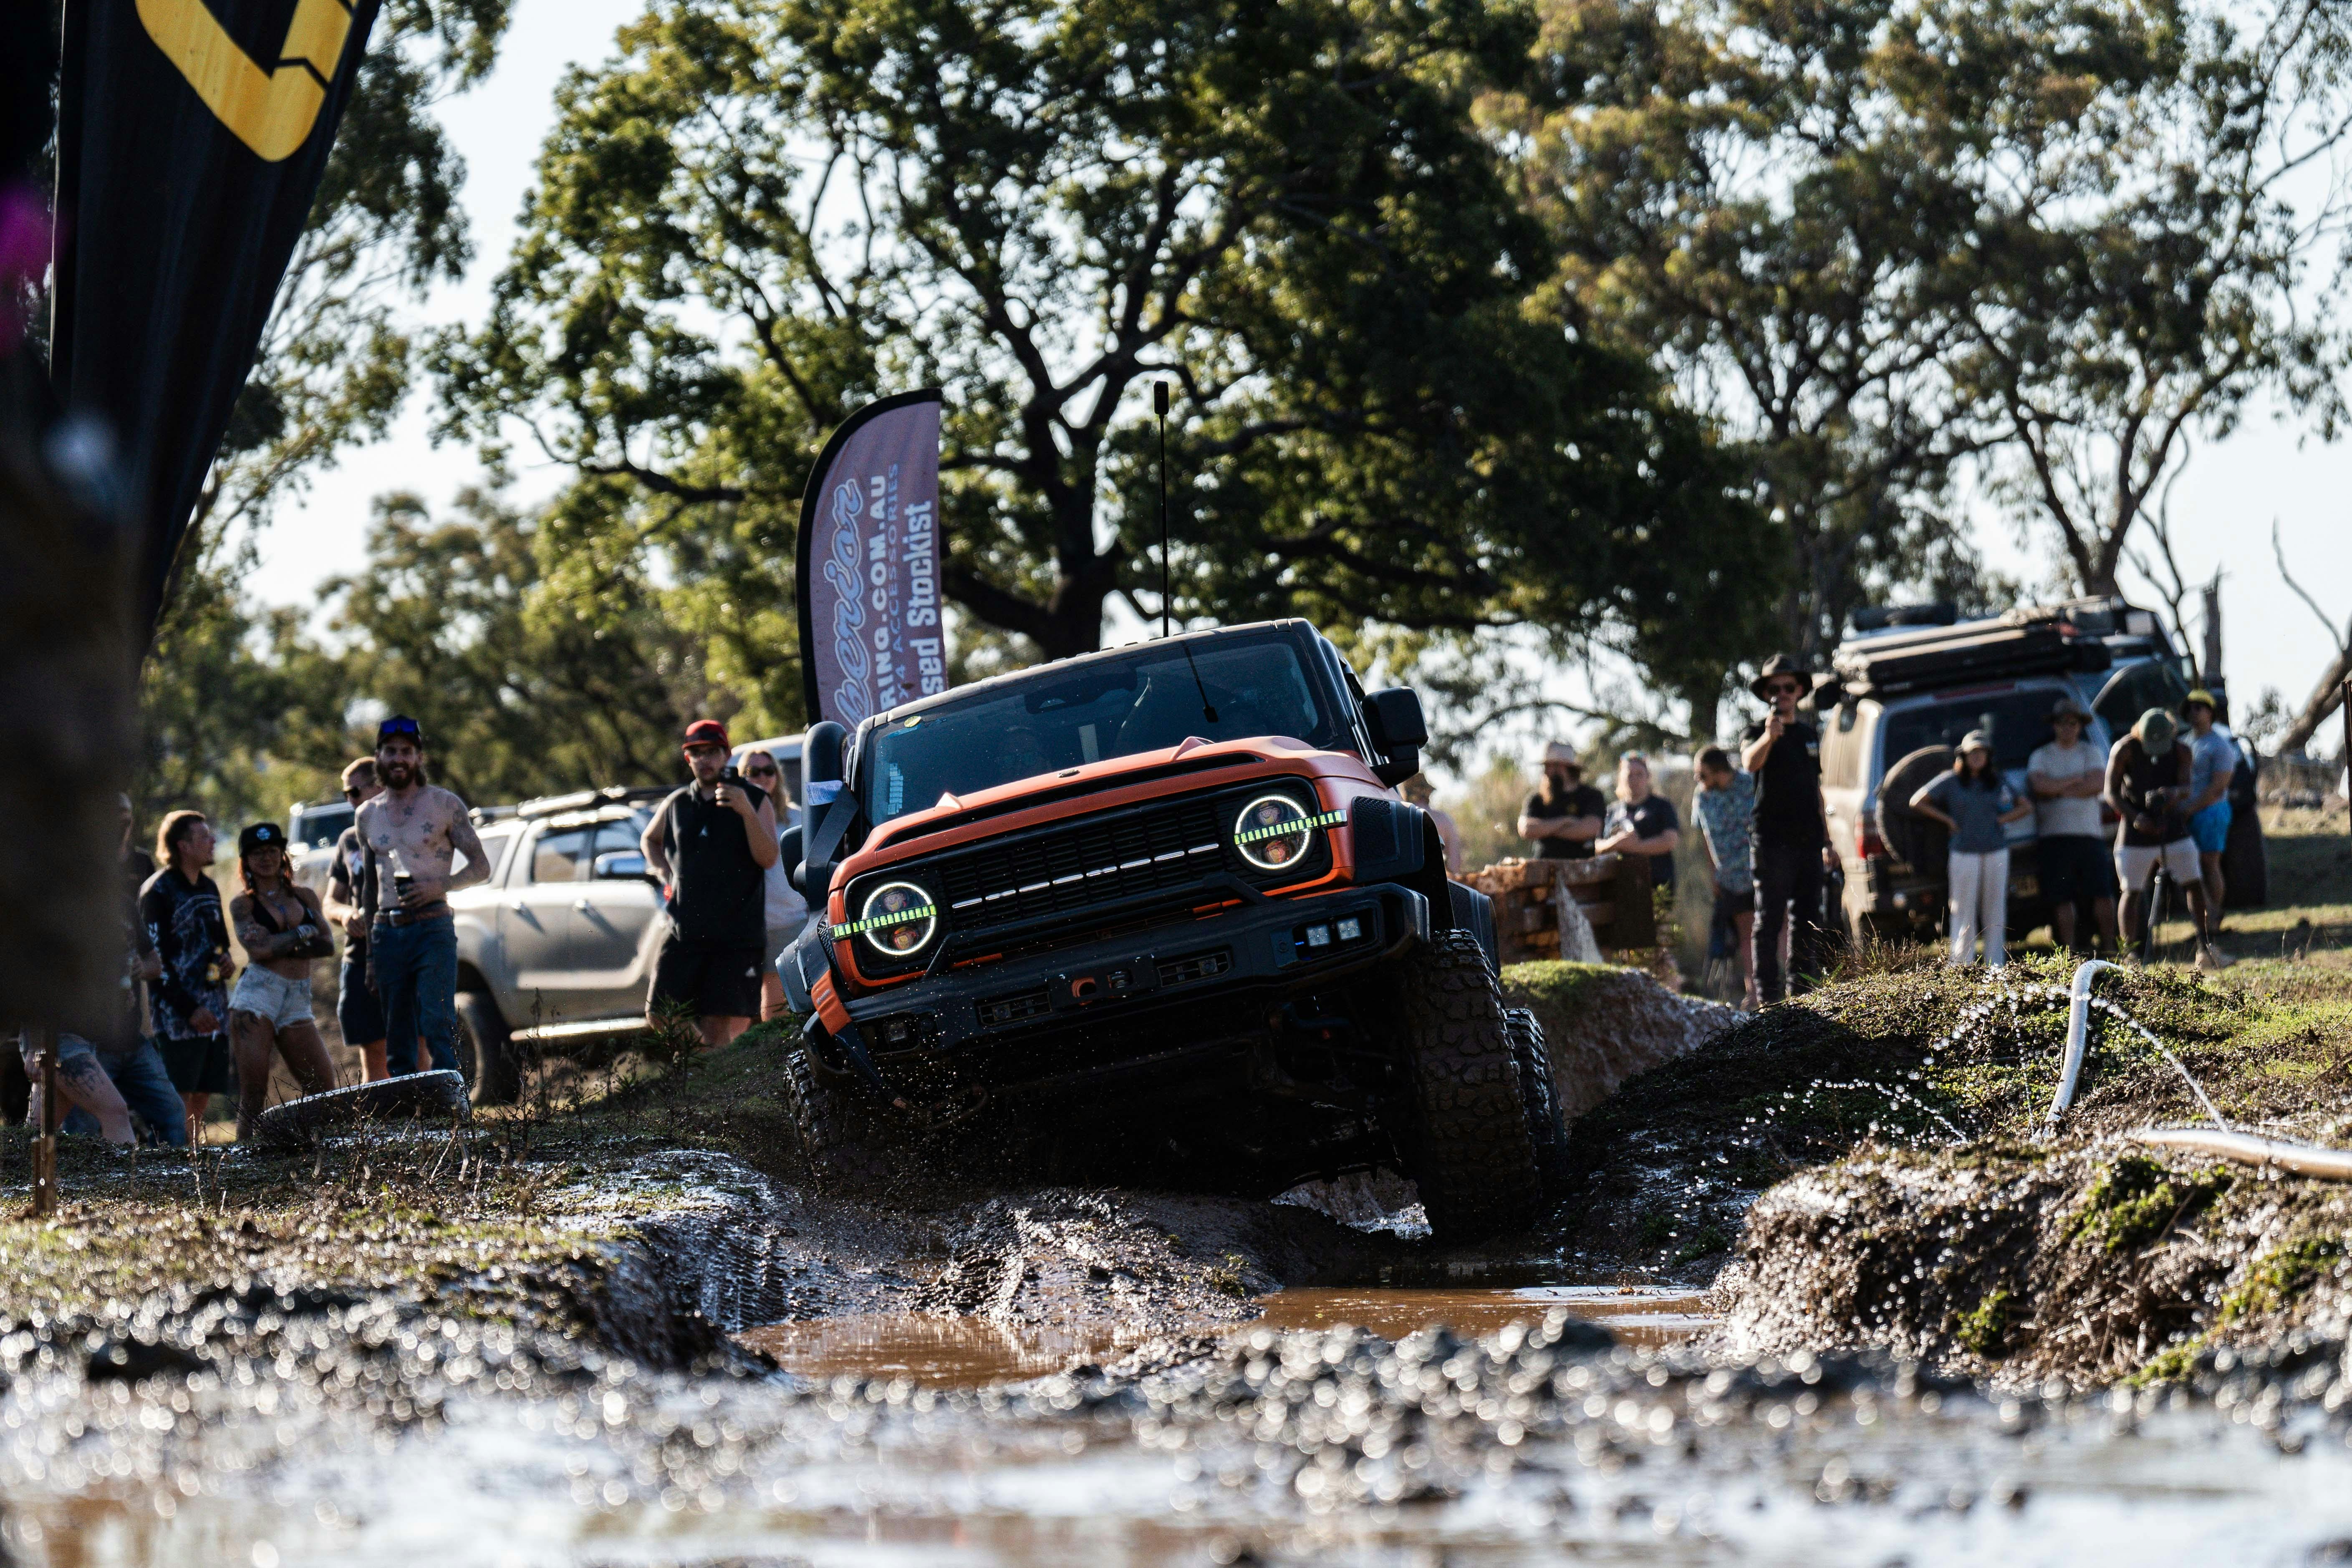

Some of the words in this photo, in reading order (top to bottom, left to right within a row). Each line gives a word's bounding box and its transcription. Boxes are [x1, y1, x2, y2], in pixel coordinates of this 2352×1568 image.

[824, 478, 873, 739] perior
[869, 475, 897, 710] RING.COM.AU
[887, 463, 903, 653] ACCESSORIES
[903, 501, 936, 627] Stockist
[895, 664, 909, 699] X4
[909, 638, 944, 697] sed
